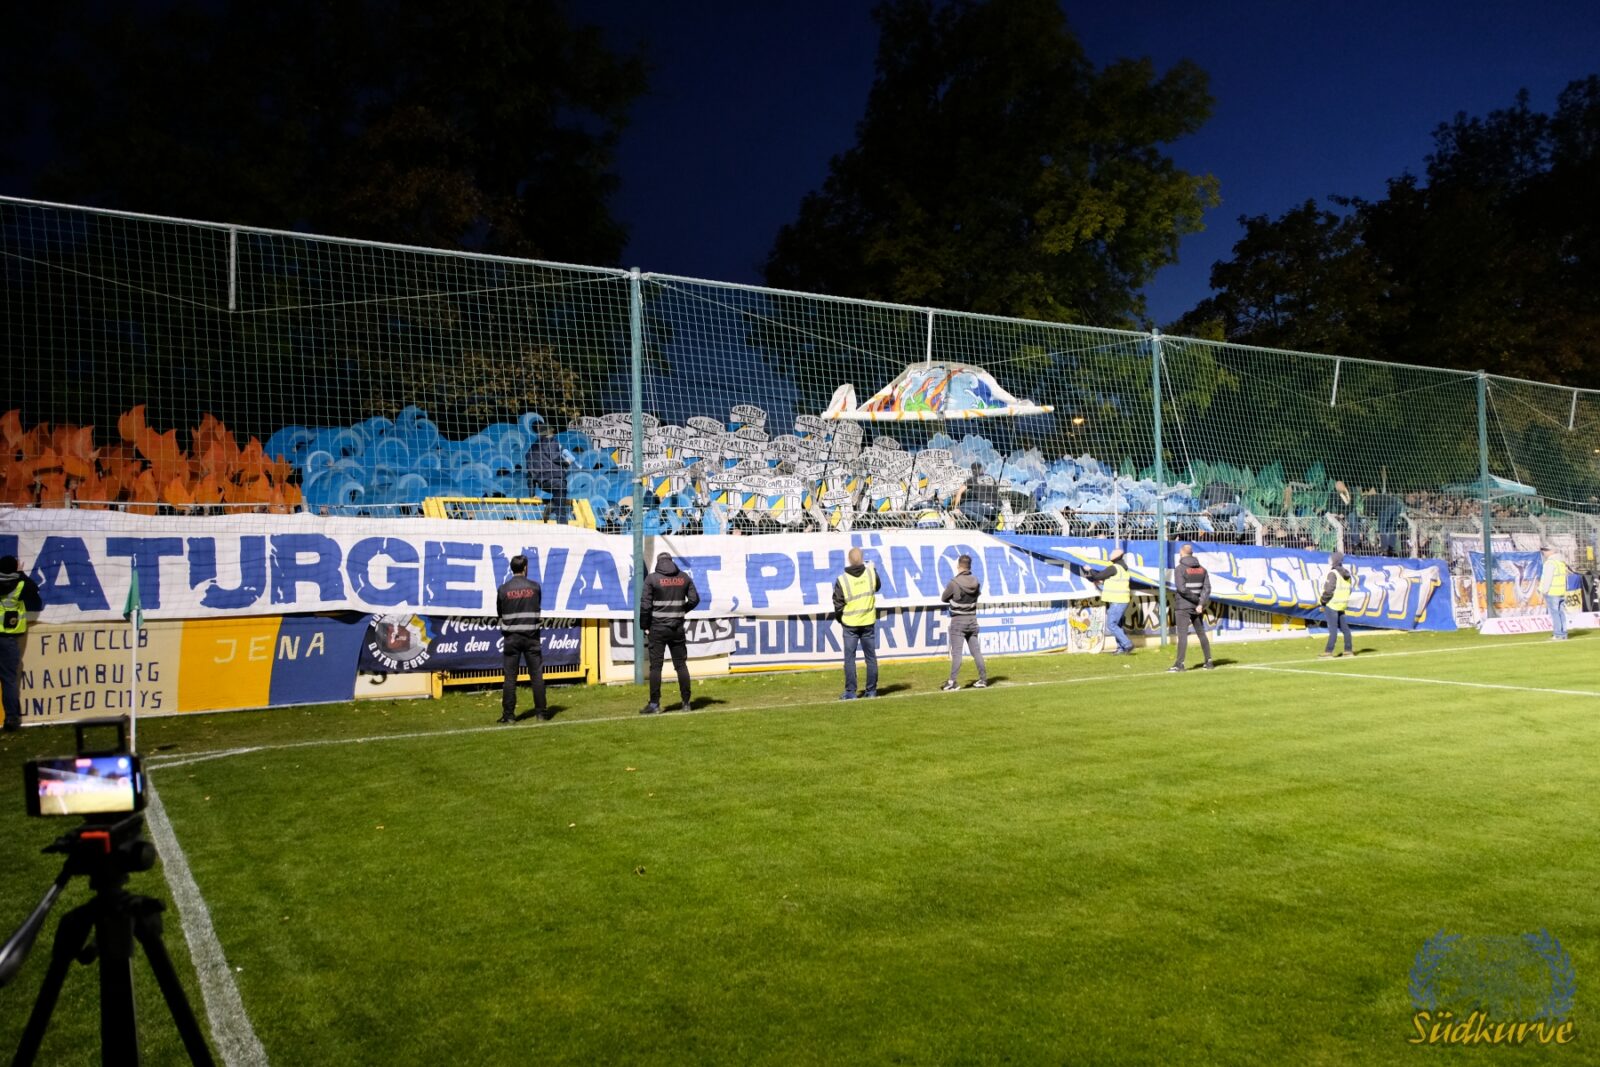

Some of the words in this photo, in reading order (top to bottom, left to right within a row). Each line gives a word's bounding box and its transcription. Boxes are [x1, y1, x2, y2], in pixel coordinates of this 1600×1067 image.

[659, 578, 685, 587] KOLOSS
[41, 632, 85, 655] FAN
[214, 632, 325, 663] JENA
[368, 642, 398, 670] QATAR
[403, 651, 431, 670] 2022
[437, 639, 458, 653] aus
[465, 636, 491, 653] dem
[549, 634, 579, 650] holen
[21, 662, 159, 690] NAUMBURG
[19, 691, 96, 717] UNITED
